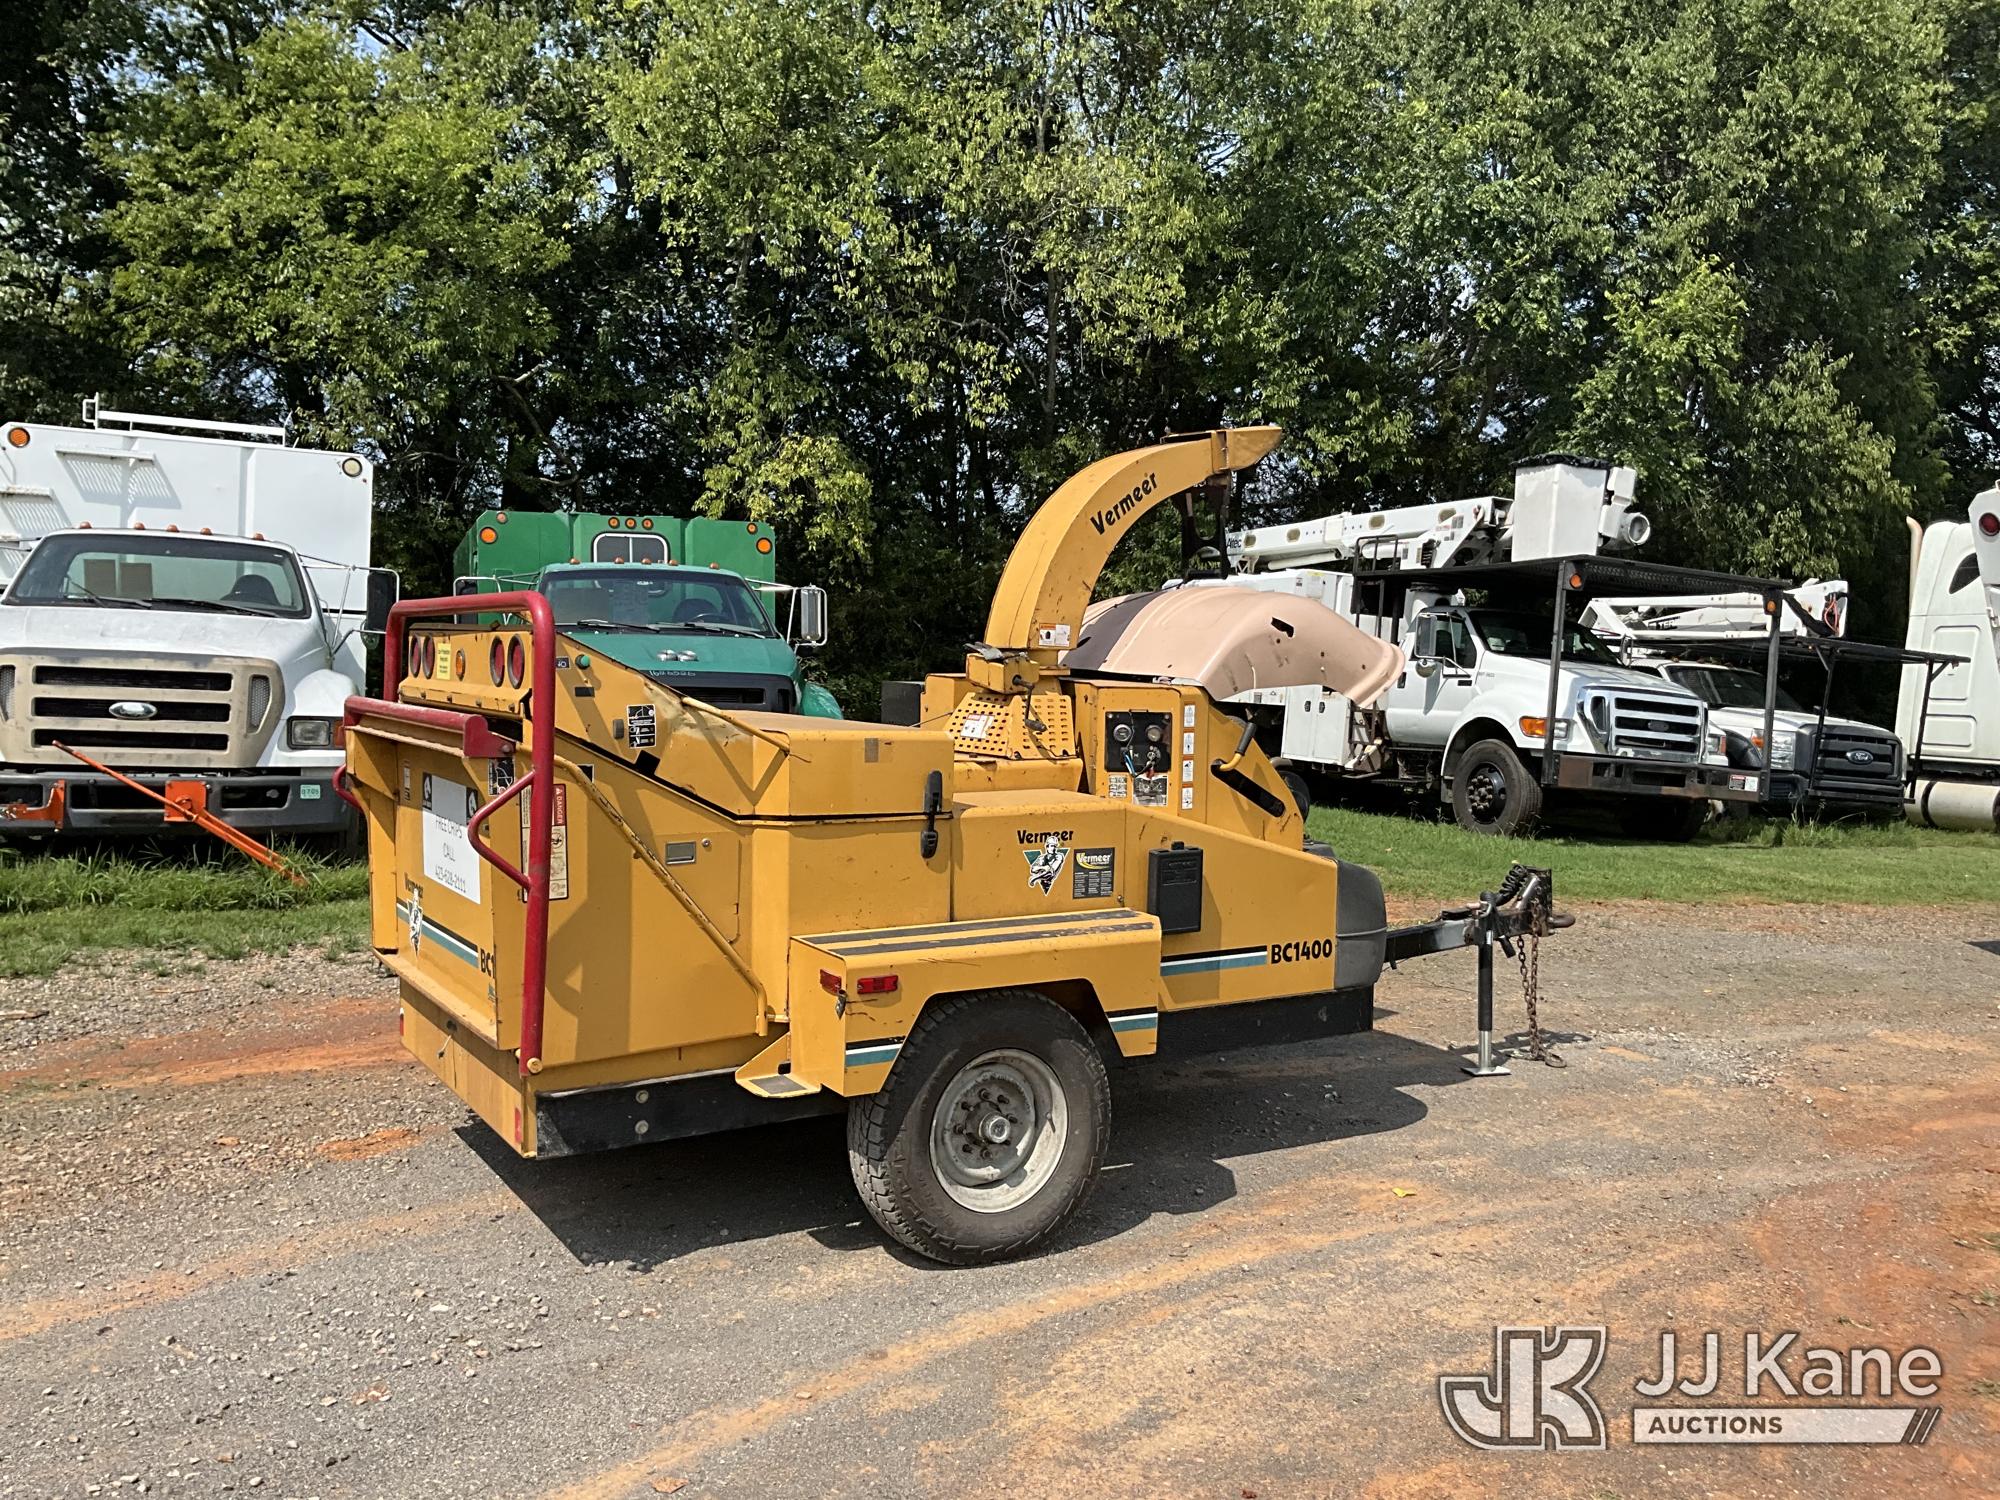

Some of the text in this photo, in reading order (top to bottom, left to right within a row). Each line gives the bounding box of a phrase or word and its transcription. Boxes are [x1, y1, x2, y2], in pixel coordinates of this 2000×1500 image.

[1090, 472, 1157, 535] Vermeer
[1016, 829, 1074, 845] Vermeer
[1076, 852, 1112, 864] Vermeer
[1271, 938, 1333, 964] BC1400
